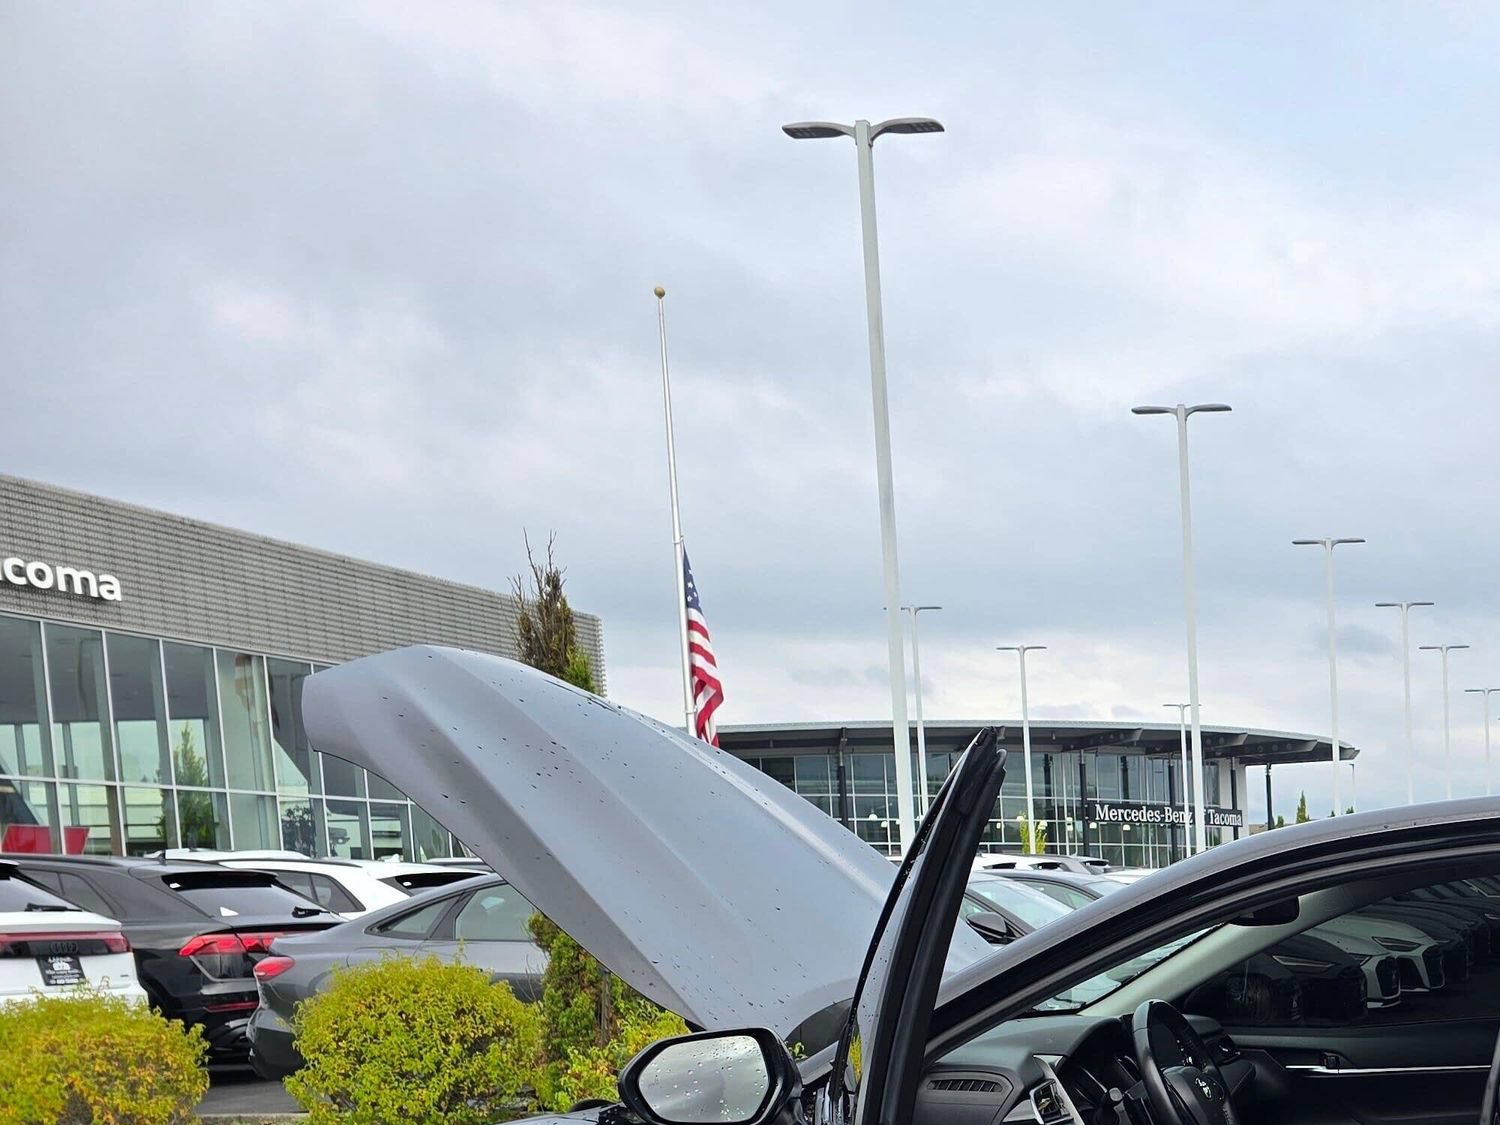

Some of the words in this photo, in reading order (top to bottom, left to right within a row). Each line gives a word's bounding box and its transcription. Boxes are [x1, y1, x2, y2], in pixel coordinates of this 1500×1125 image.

[0, 557, 122, 601] coma
[1095, 803, 1193, 824] Mercedes-Benz
[1207, 809, 1242, 826] Tacoma
